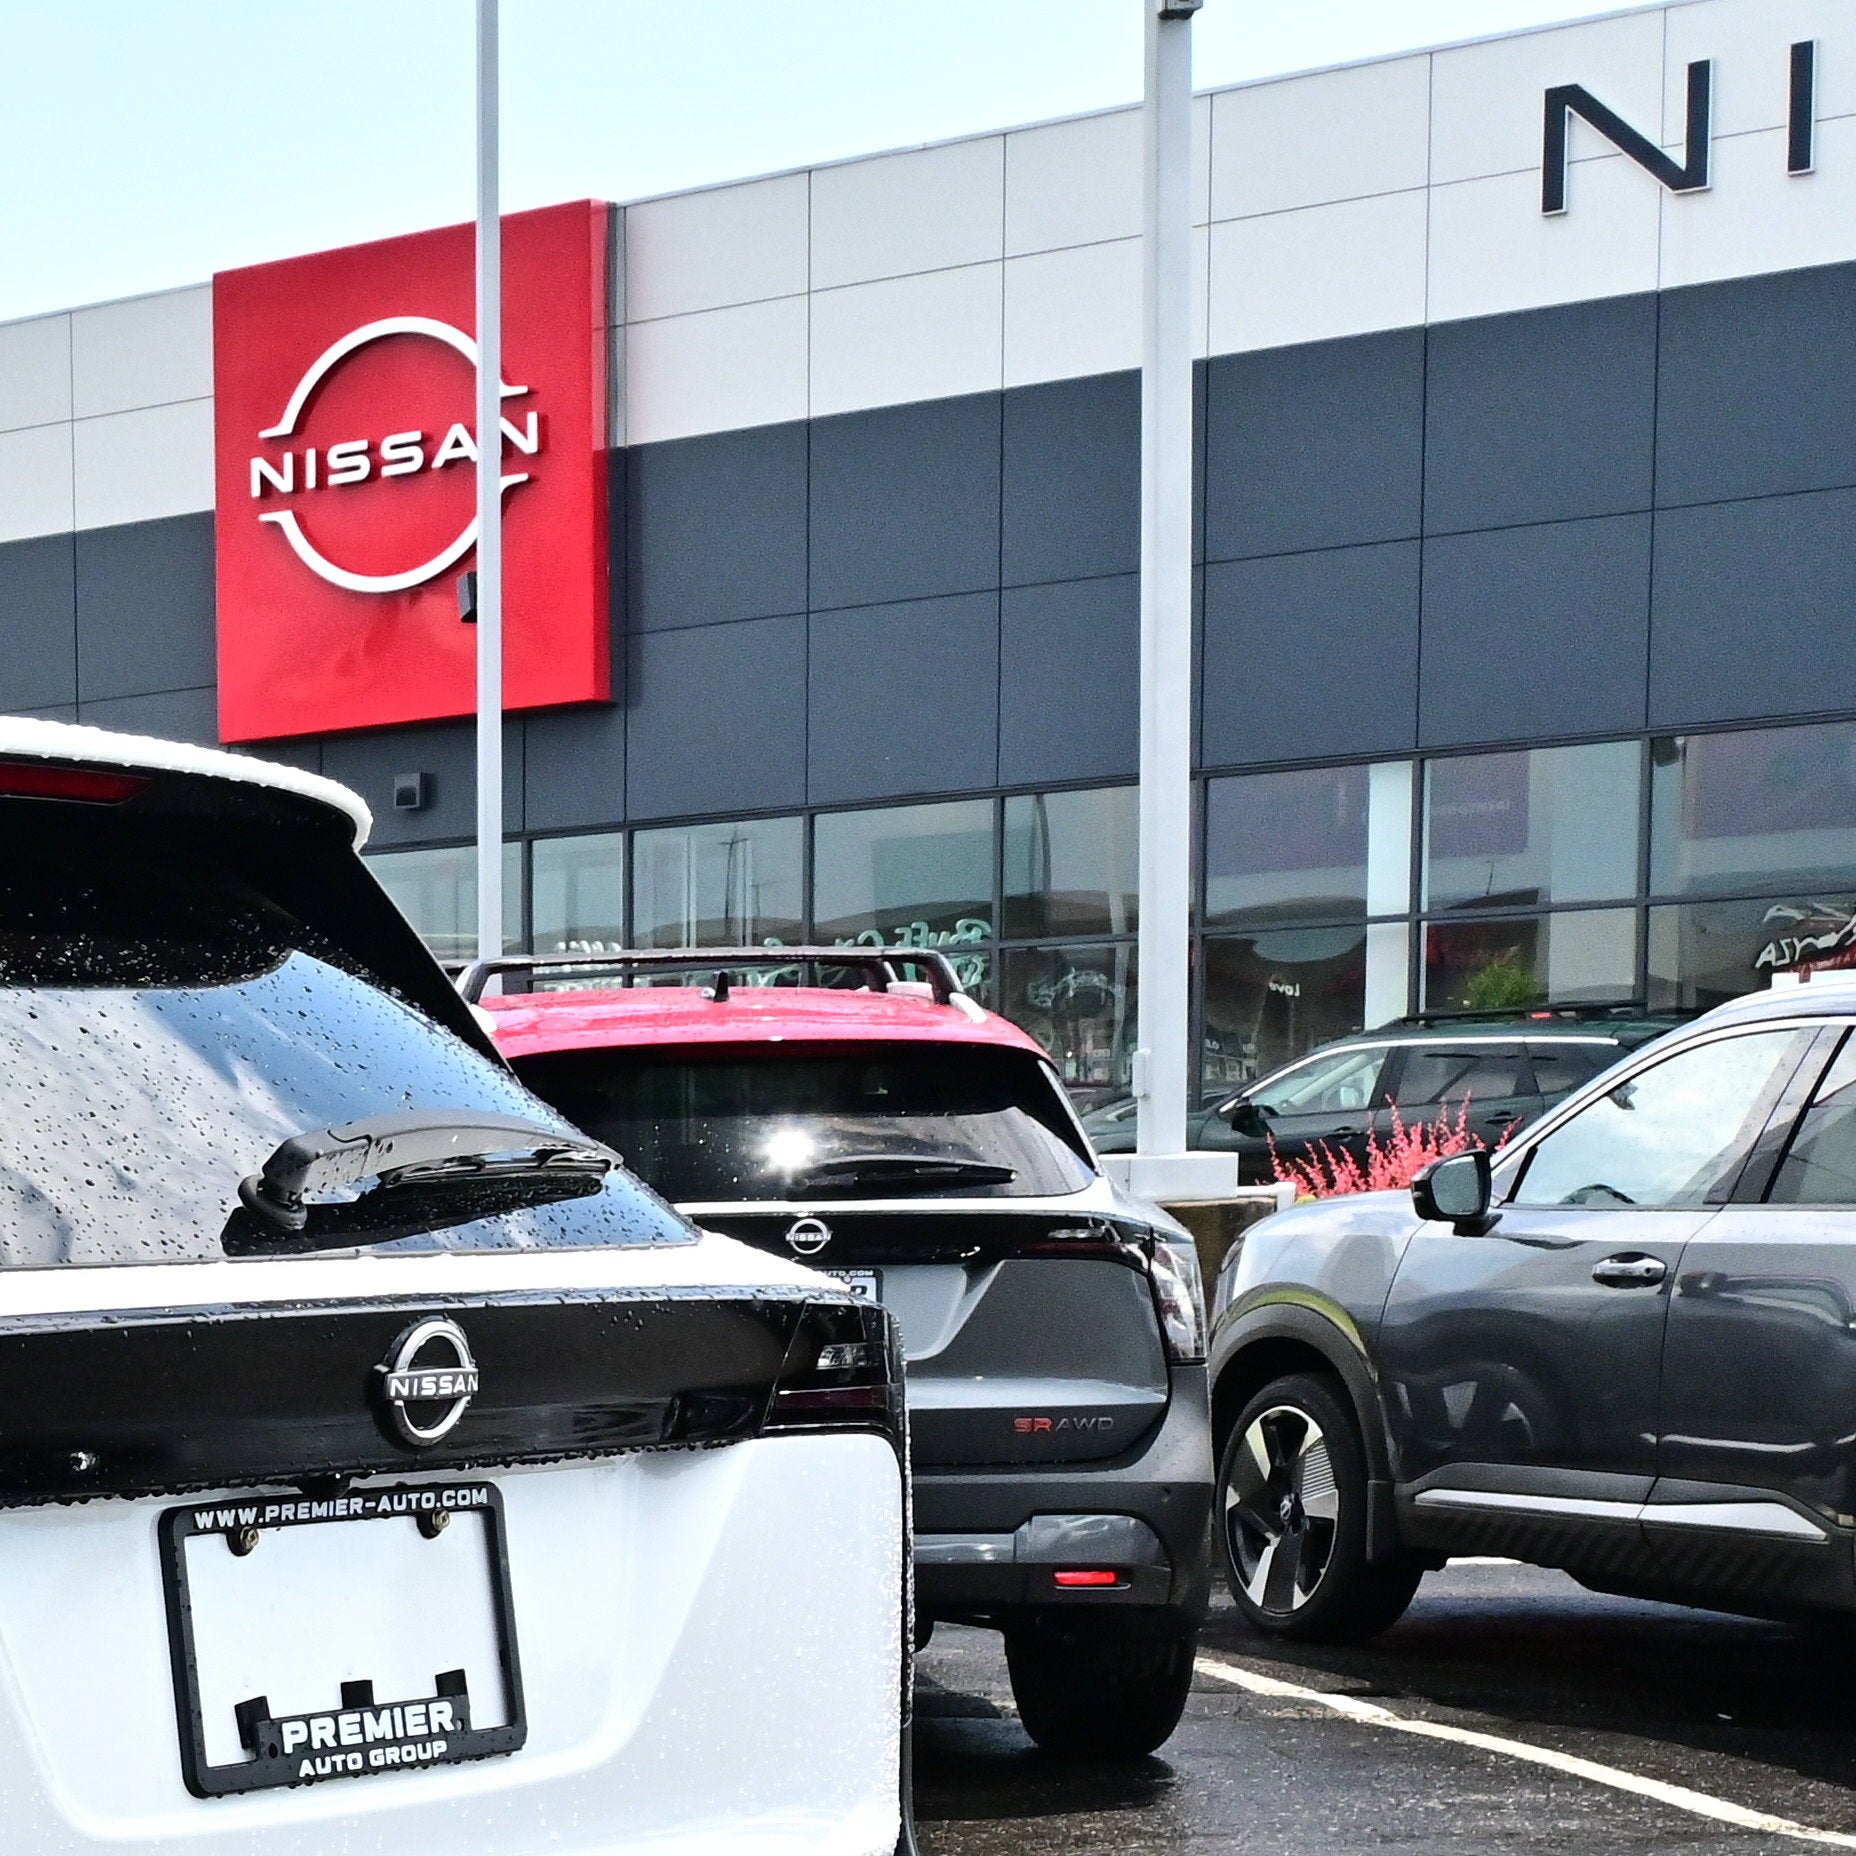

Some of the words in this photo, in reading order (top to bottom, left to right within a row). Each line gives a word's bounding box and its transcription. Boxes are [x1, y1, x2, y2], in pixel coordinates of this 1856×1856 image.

[249, 410, 539, 499] NISSAN
[389, 1372, 479, 1397] NISSAN
[1013, 1417, 1053, 1433] SR
[1054, 1417, 1115, 1433] AWD
[194, 1487, 488, 1529] WWW.PREMIER-AUTO.COM
[281, 1701, 455, 1754] PREMIER
[298, 1751, 364, 1778] AUTO
[368, 1740, 448, 1767] GROUP
